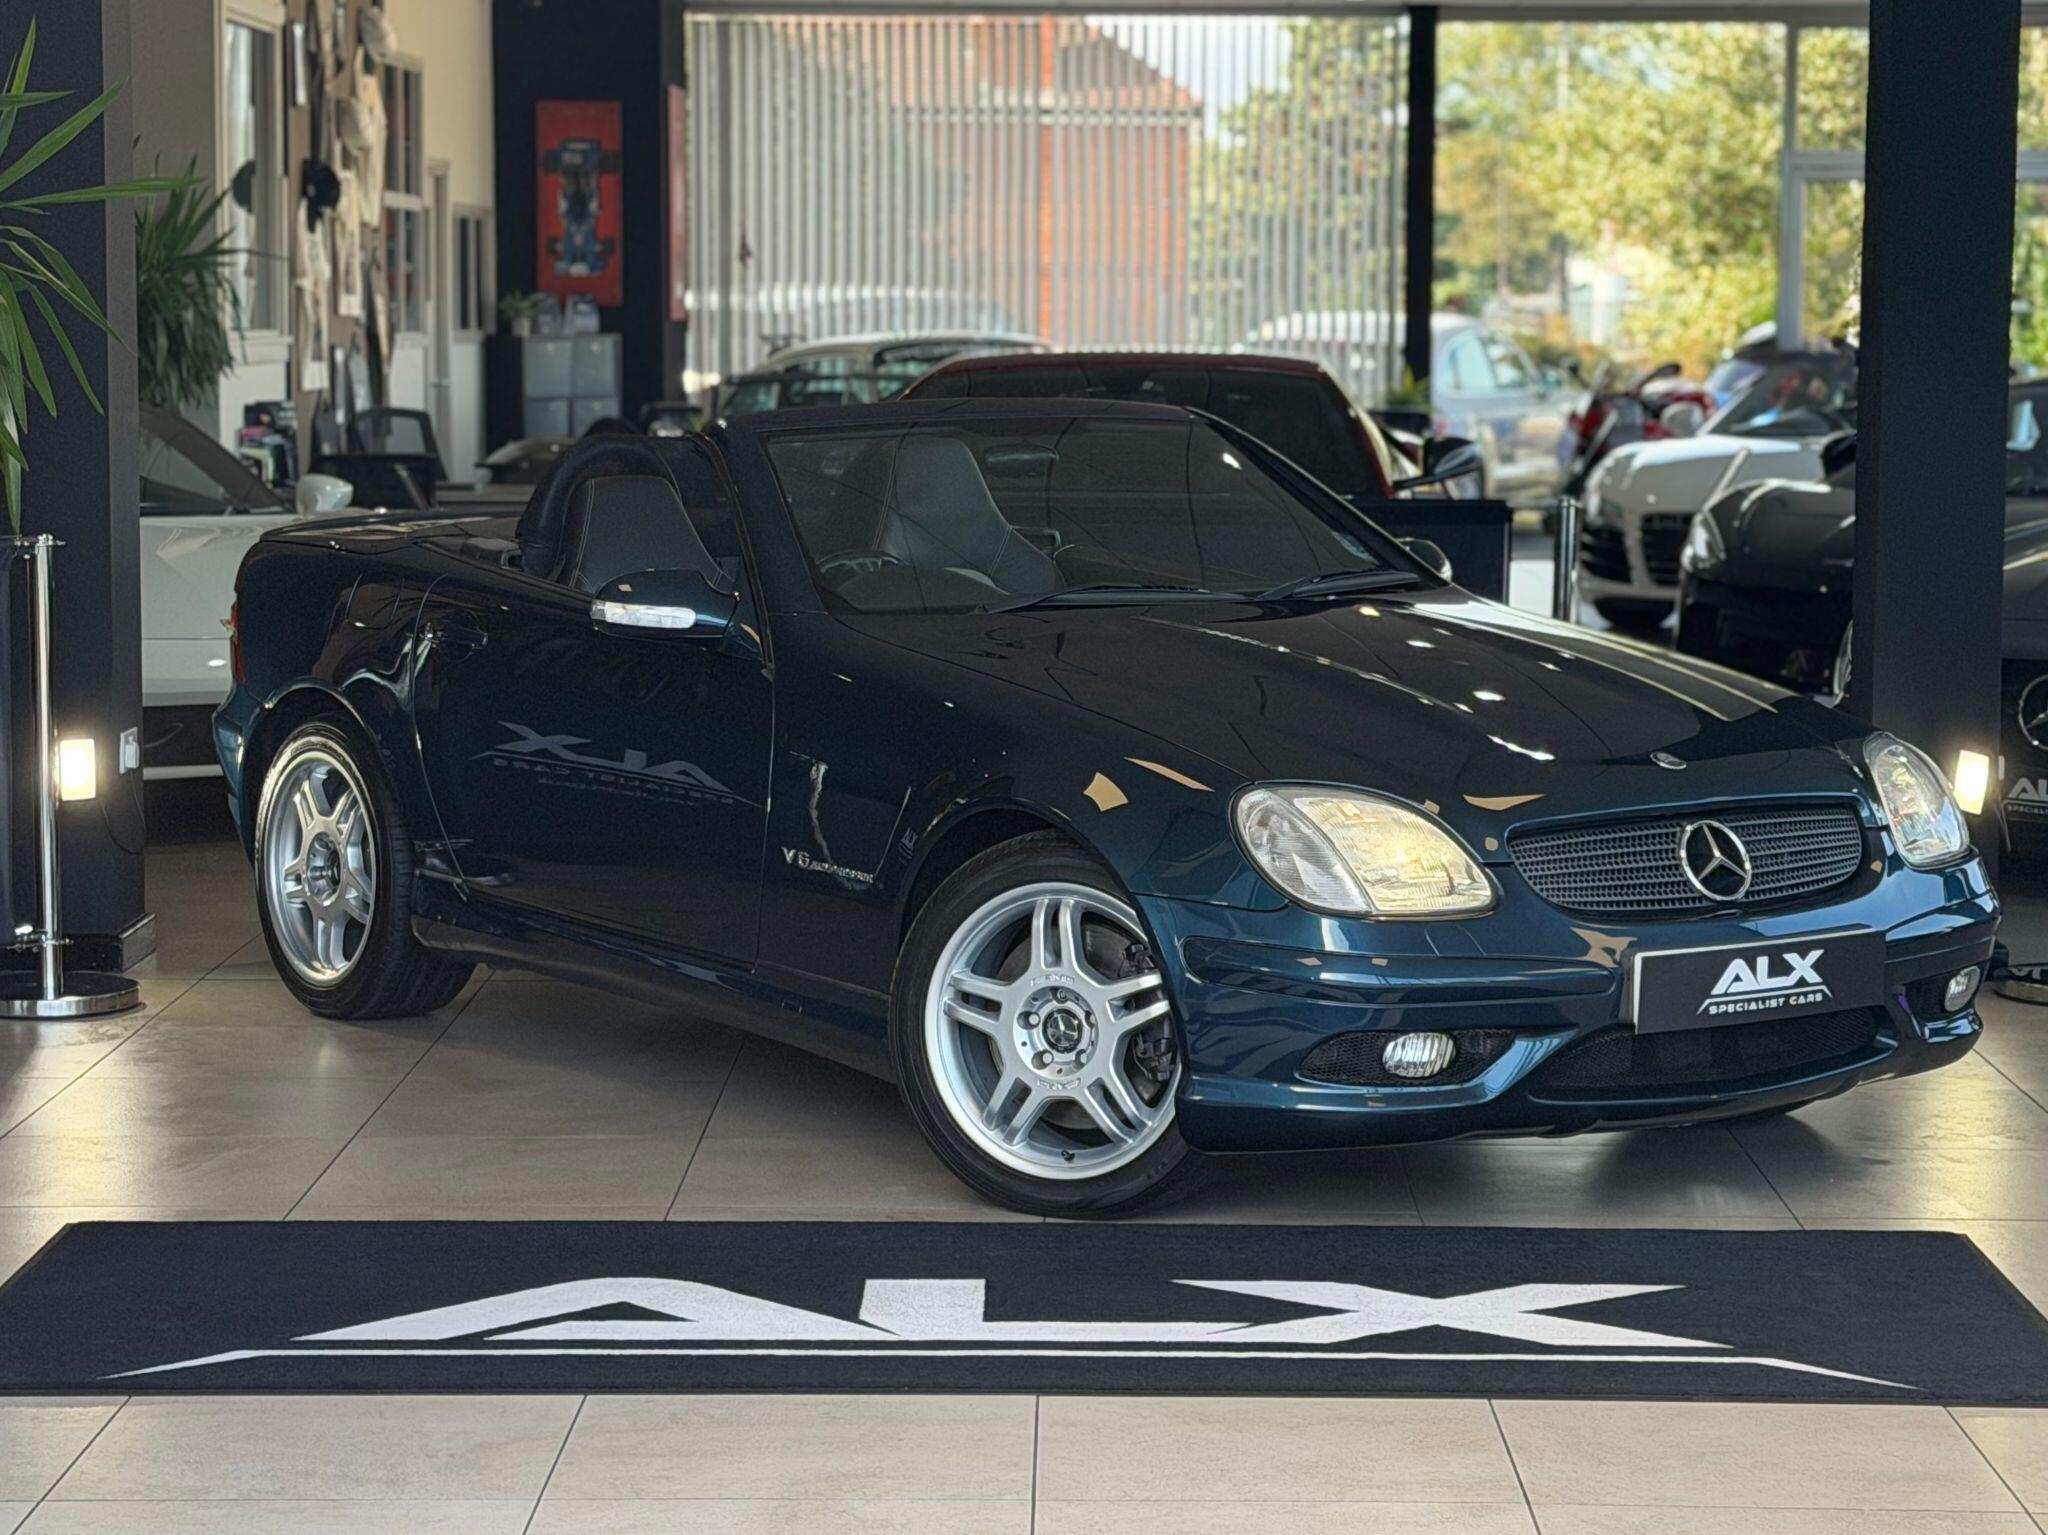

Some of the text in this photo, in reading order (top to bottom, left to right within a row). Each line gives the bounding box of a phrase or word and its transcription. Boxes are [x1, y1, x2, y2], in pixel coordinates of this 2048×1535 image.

[1711, 949, 1825, 996] ALX
[1709, 993, 1823, 1015] SPECIALIST CARS
[294, 1277, 1733, 1349] ALX
